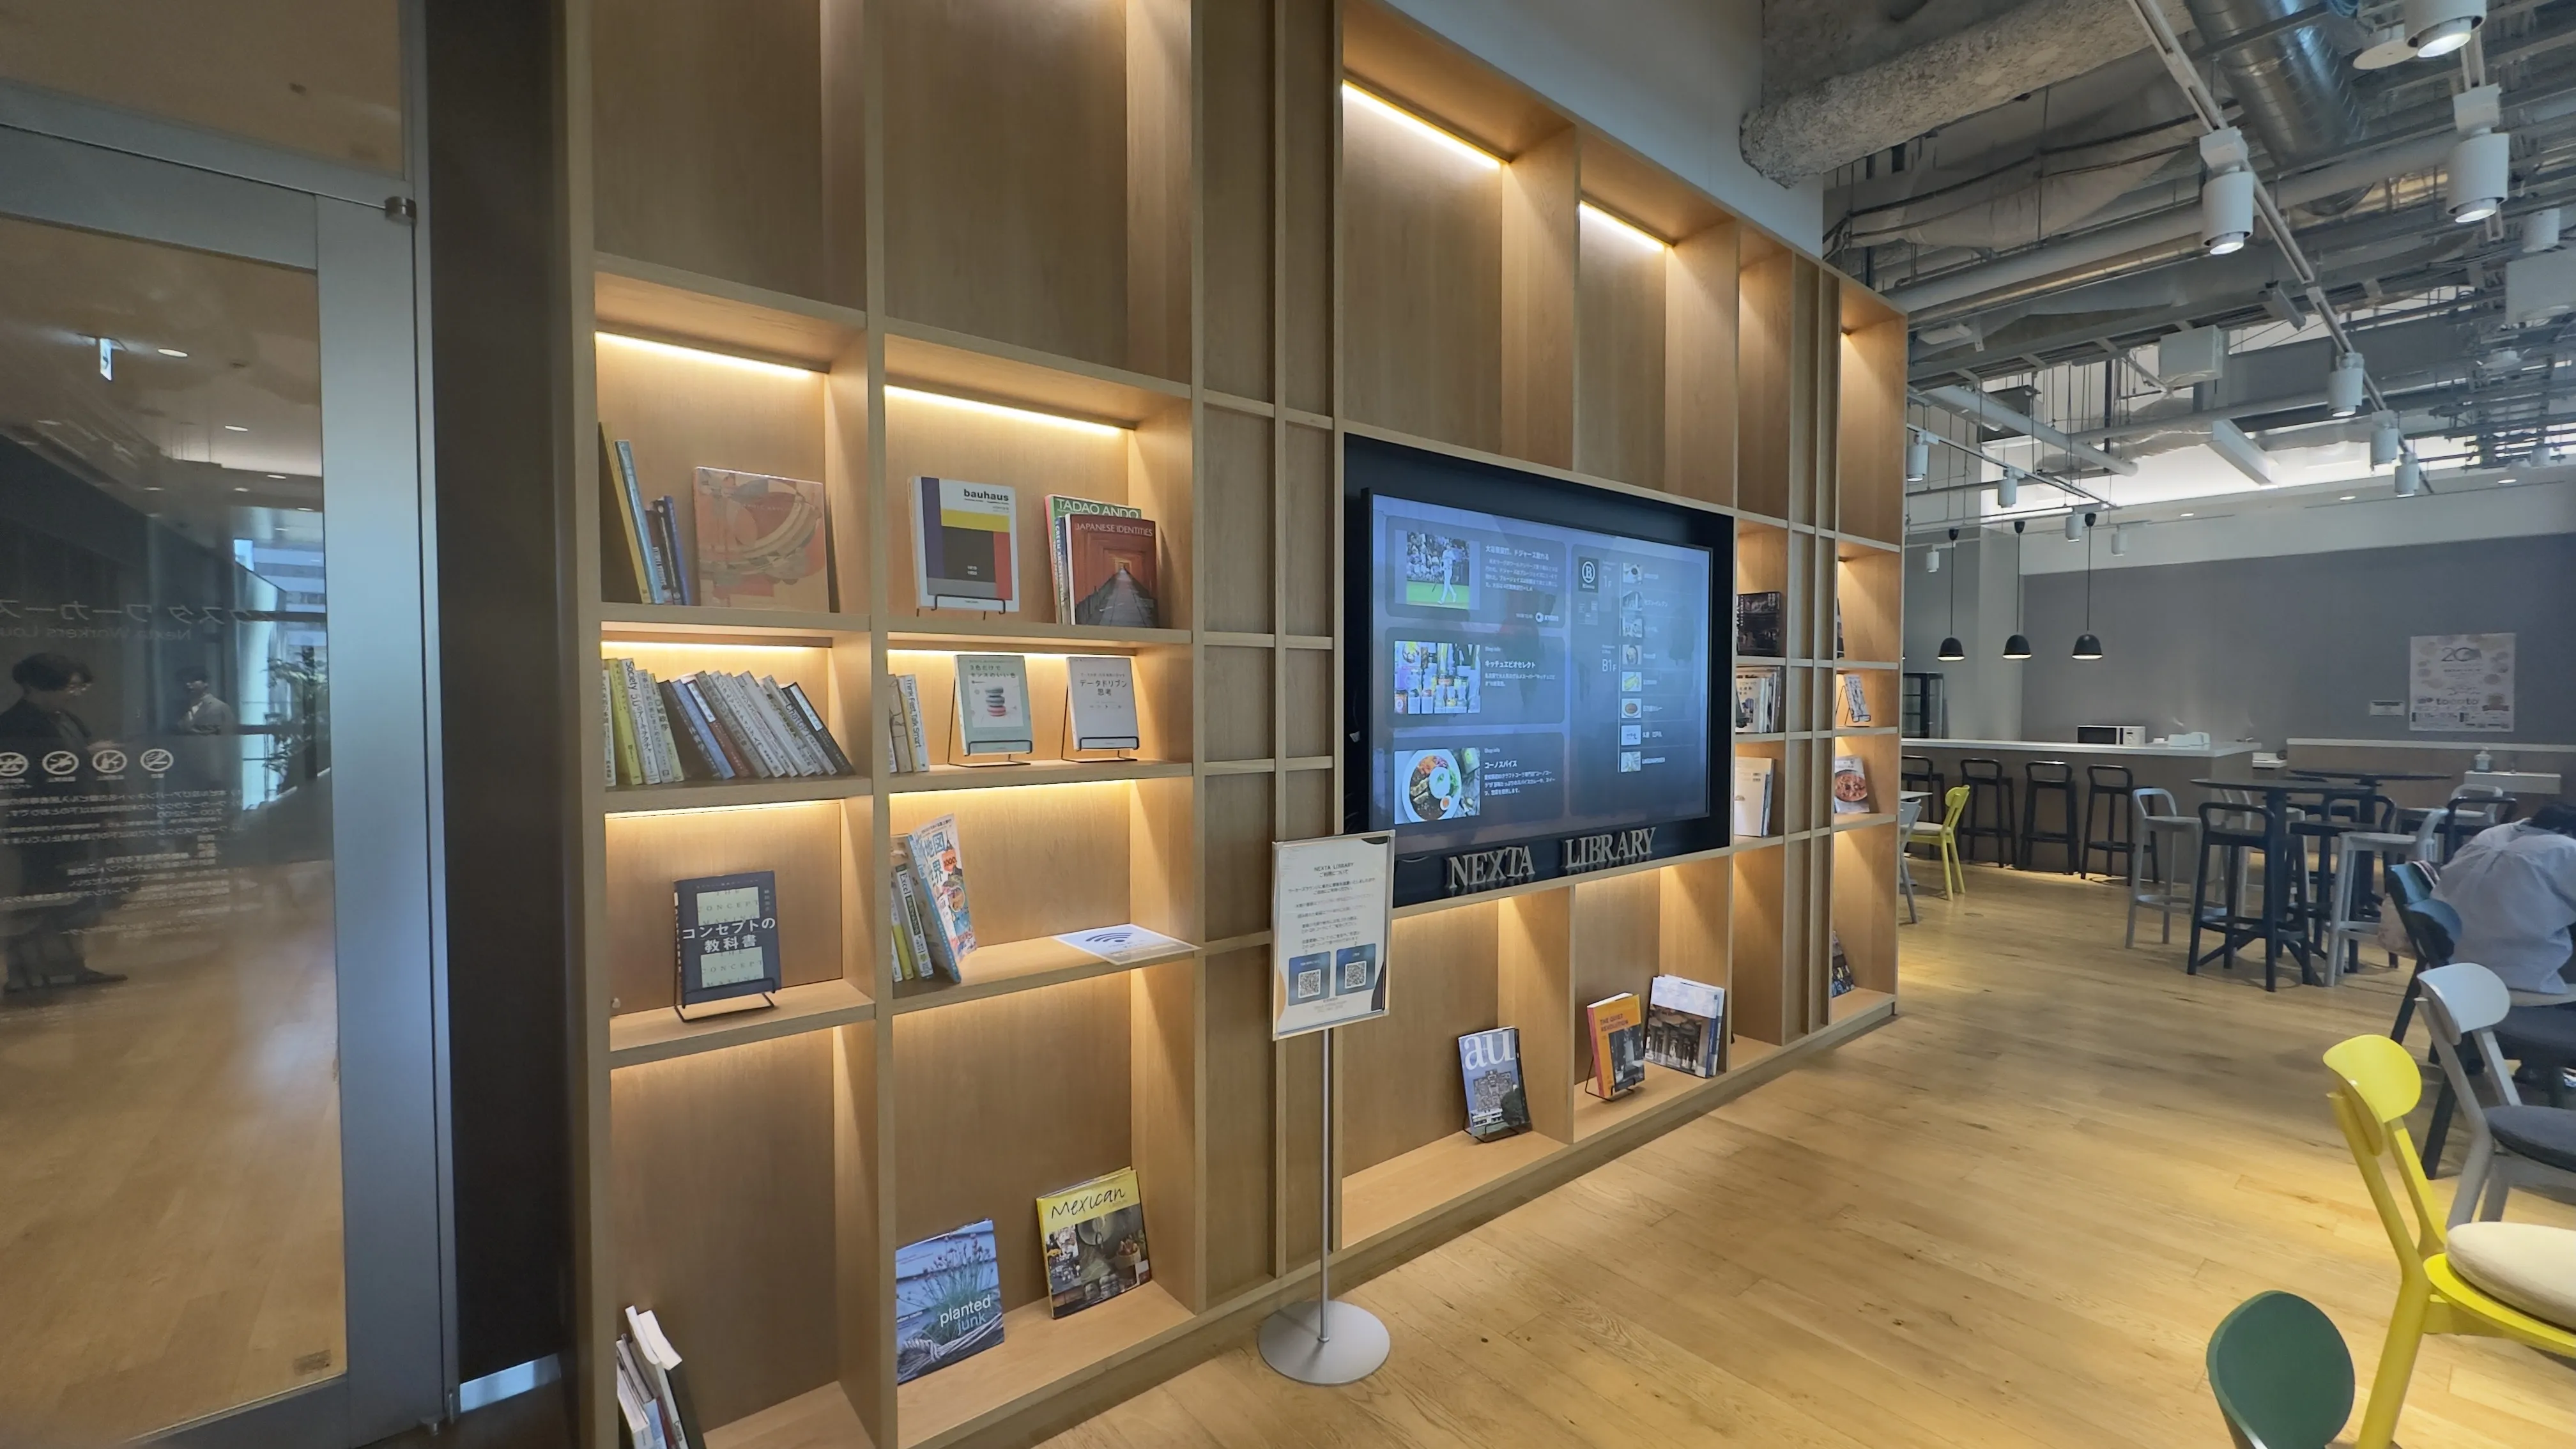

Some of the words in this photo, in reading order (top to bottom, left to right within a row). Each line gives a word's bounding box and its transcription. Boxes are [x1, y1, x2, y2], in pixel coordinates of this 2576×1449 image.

[963, 489, 1009, 502] bauhaus
[1057, 498, 1100, 514] TADAO
[1102, 506, 1138, 519] ANDO
[1076, 523, 1114, 532] JAPANESE
[1117, 525, 1153, 537] IDENTITIES
[625, 661, 638, 691] Society
[1602, 659, 1617, 672] B1F
[1484, 760, 1517, 769] コーノスパイス
[1449, 845, 1535, 889] NEXTA
[1565, 827, 1657, 869] LIBRARY
[899, 873, 911, 896] Excel
[682, 917, 776, 939] コンセプトの
[704, 934, 757, 953] 教科書
[1609, 1013, 1623, 1022] QUIET
[1052, 1185, 1126, 1220] Mexican
[939, 1294, 992, 1328] planted
[957, 1311, 986, 1336] junk
